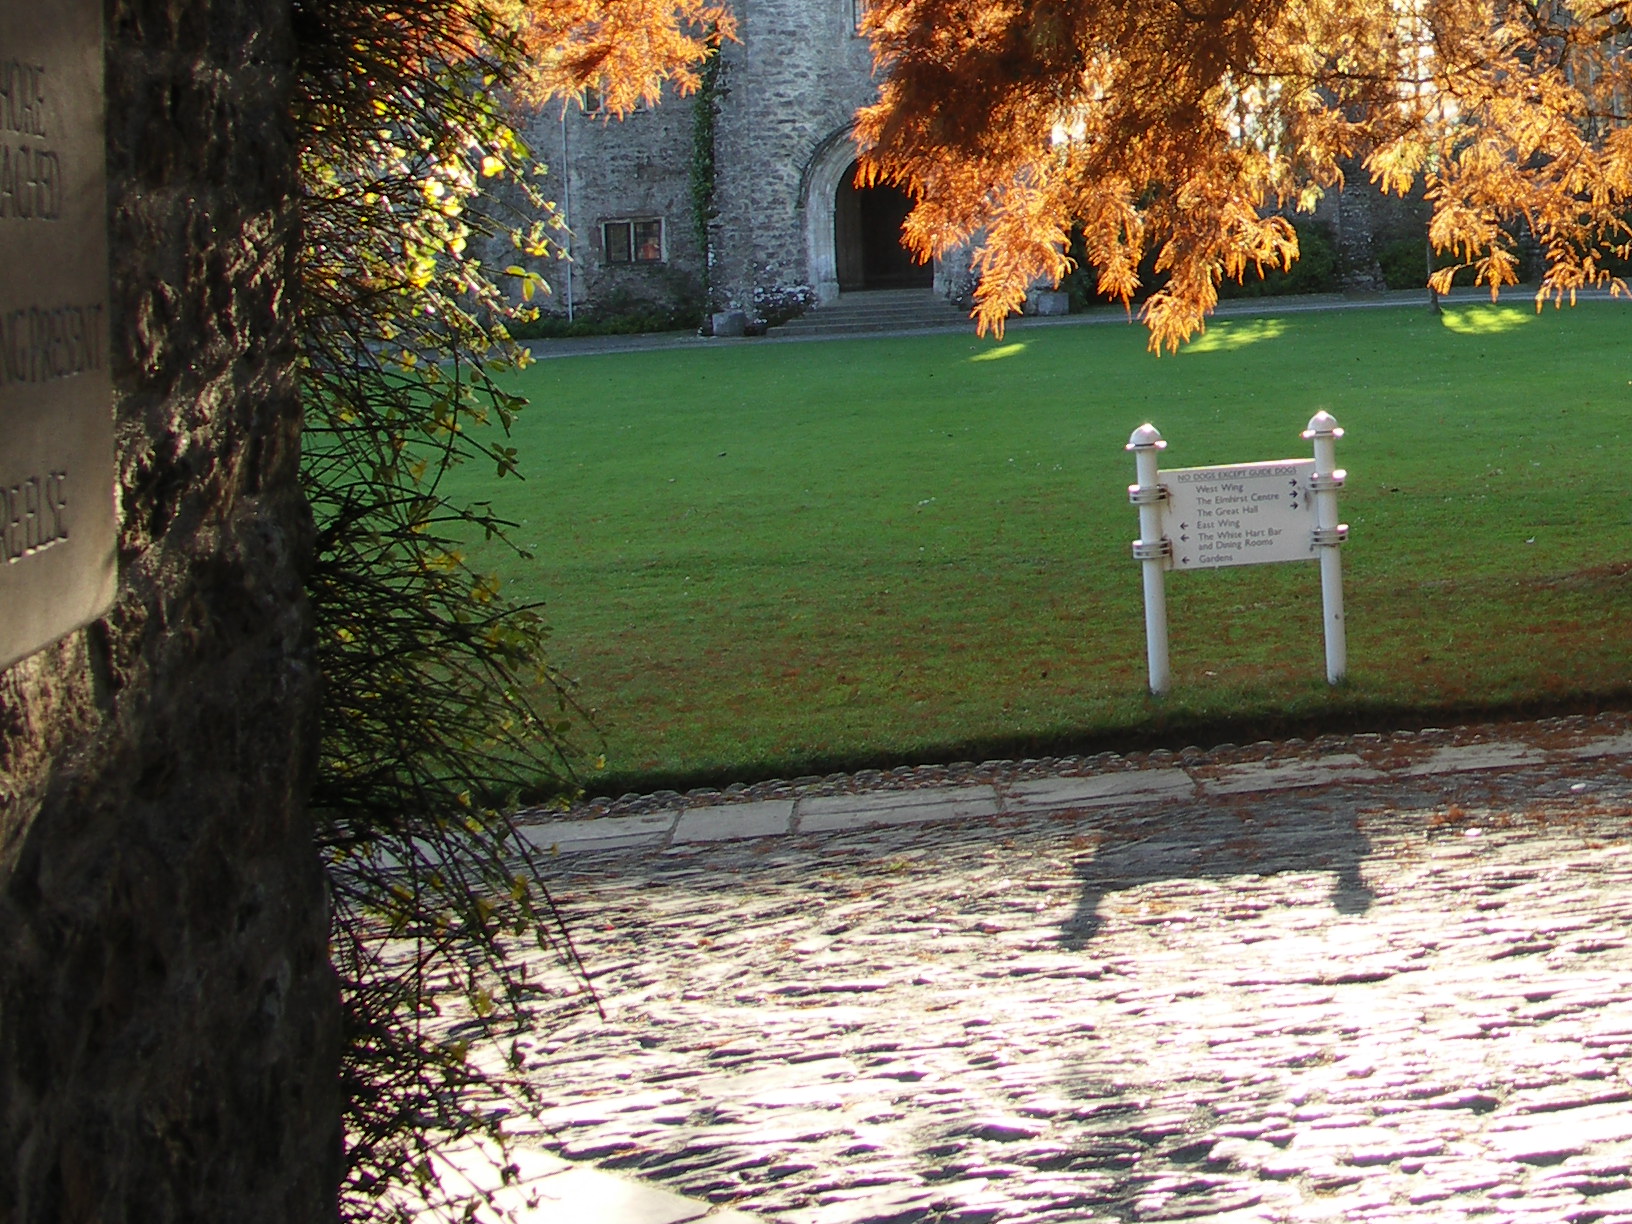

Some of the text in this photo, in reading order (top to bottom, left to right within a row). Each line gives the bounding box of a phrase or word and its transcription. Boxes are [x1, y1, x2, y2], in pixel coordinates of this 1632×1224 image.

[0, 143, 62, 219] ACHED
[27, 303, 102, 382] PRESENT
[1178, 466, 1297, 483] NO DOGS EXCEPT GUIDE DOGS
[1196, 483, 1244, 493] West Wing
[1197, 493, 1279, 505] The Elmhirst Centre
[24, 469, 69, 555] ELSE
[1197, 505, 1258, 517] The Great Hall
[1197, 519, 1241, 529] East Wing
[1198, 527, 1282, 541] The White Hart Bar
[1198, 538, 1273, 551] and Dining Rooms
[1199, 554, 1233, 563] Gardens
